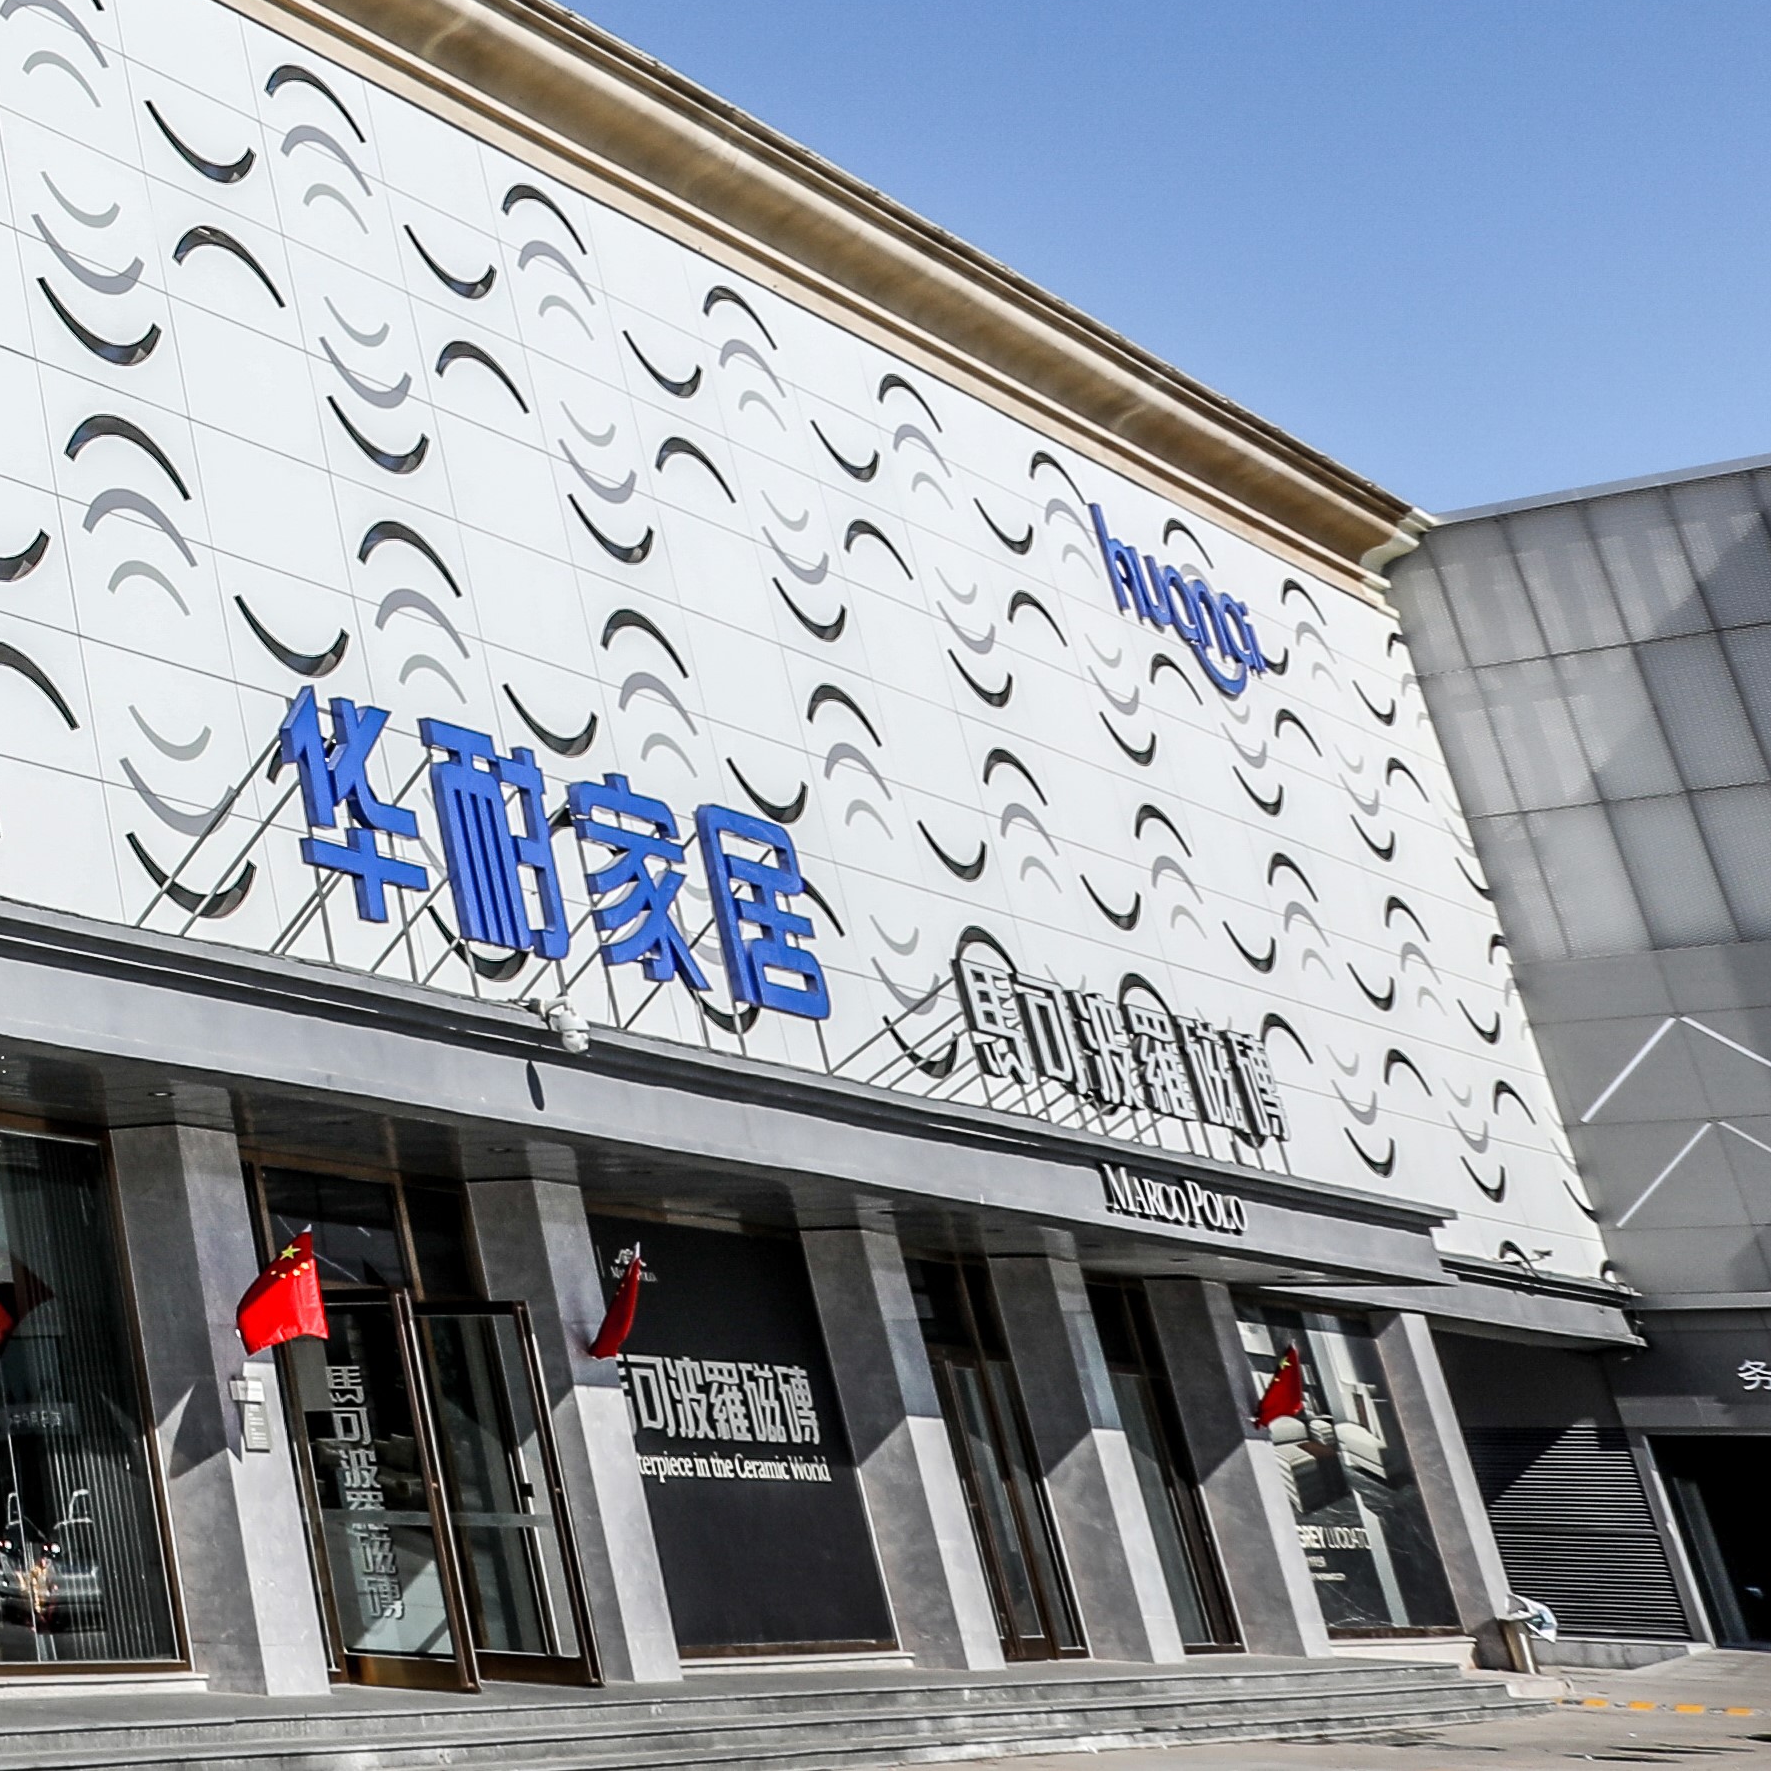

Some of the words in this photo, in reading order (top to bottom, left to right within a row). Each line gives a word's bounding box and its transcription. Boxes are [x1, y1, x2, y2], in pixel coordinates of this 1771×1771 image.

[280, 684, 831, 1020] 华耐家居
[637, 1450, 692, 1483] terpiece
[693, 1451, 710, 1477] in
[712, 1451, 734, 1478] the
[736, 1453, 789, 1480] Ceramic
[790, 1456, 832, 1482] World
